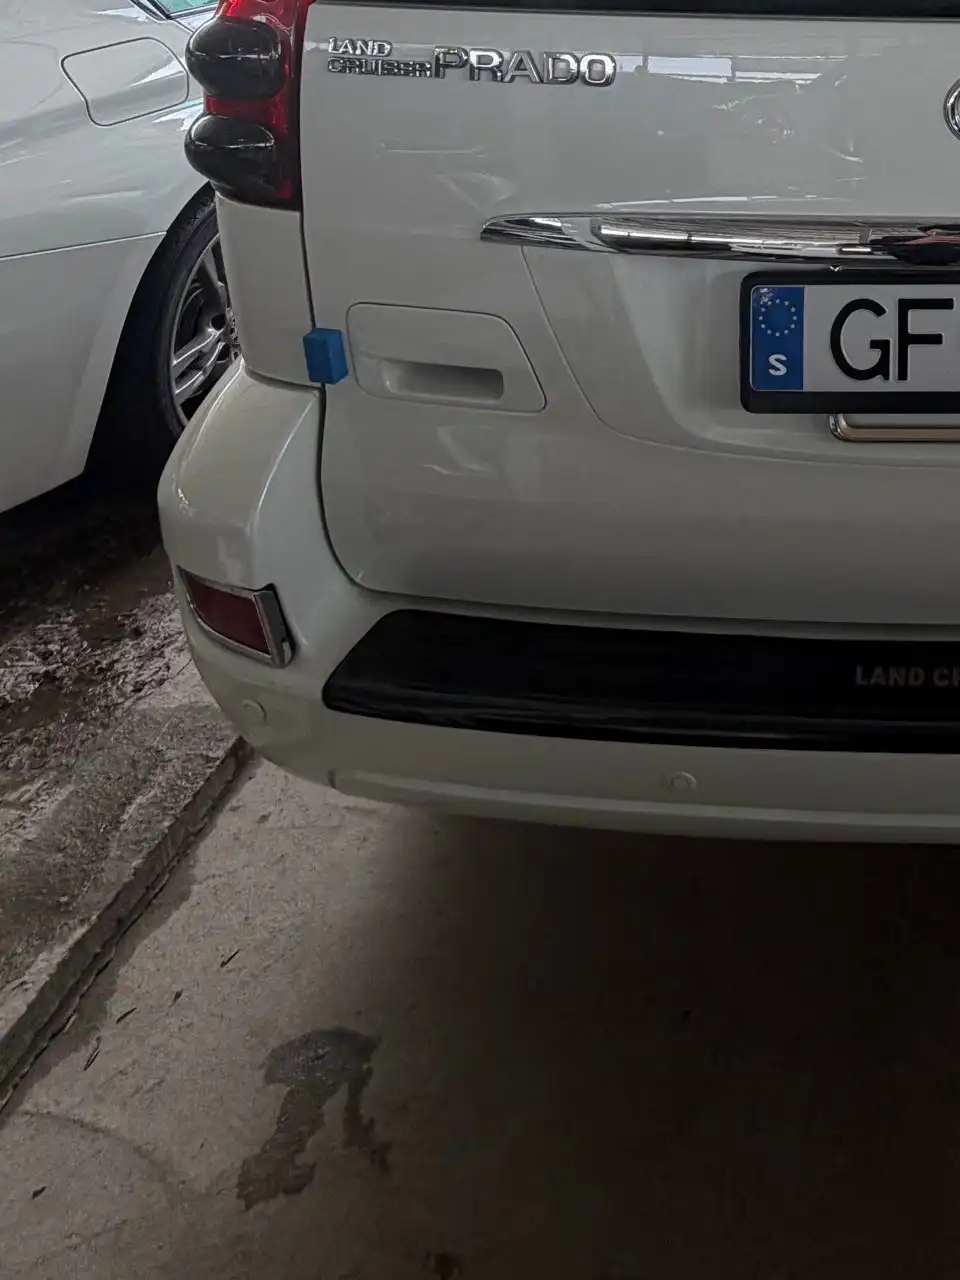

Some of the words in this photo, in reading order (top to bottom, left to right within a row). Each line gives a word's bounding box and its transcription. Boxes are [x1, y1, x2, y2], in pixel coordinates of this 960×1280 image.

[328, 36, 393, 57] LAND
[327, 57, 433, 79] CRUISER
[434, 46, 617, 87] PRADO
[768, 353, 788, 376] S
[854, 664, 925, 687] LAND
